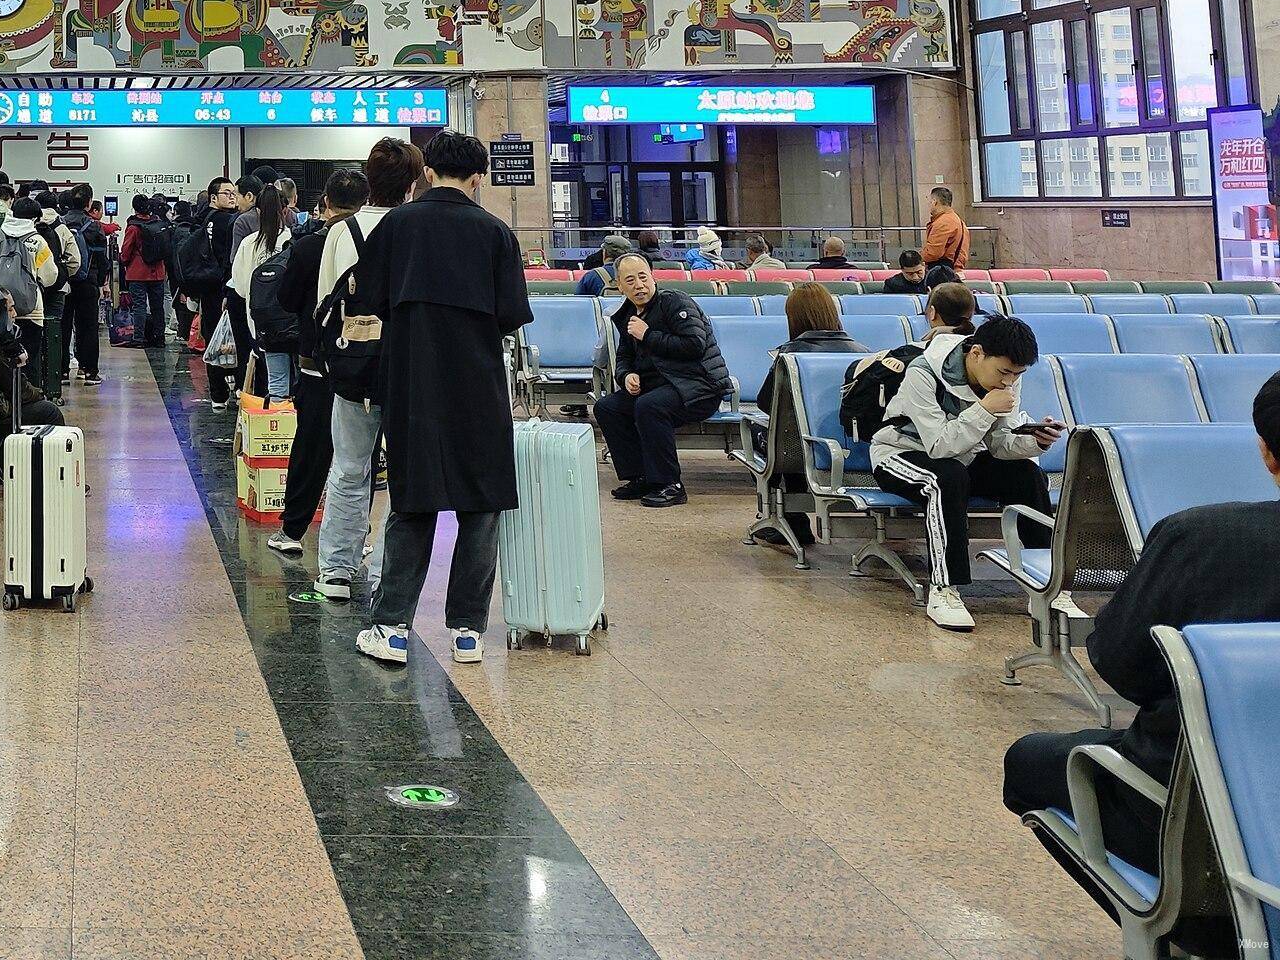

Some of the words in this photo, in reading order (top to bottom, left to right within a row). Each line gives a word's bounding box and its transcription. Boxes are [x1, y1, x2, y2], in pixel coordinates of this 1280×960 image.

[72, 92, 95, 105] 车次
[201, 92, 225, 105] 开点
[258, 92, 283, 104] 站台
[600, 89, 610, 103] 4
[697, 90, 815, 110] 太原站欢迎您
[397, 107, 441, 123] 检票口
[1220, 138, 1265, 156] 龙年开仓
[1220, 157, 1267, 174] 万和红四
[123, 174, 185, 184] 广告位招商中
